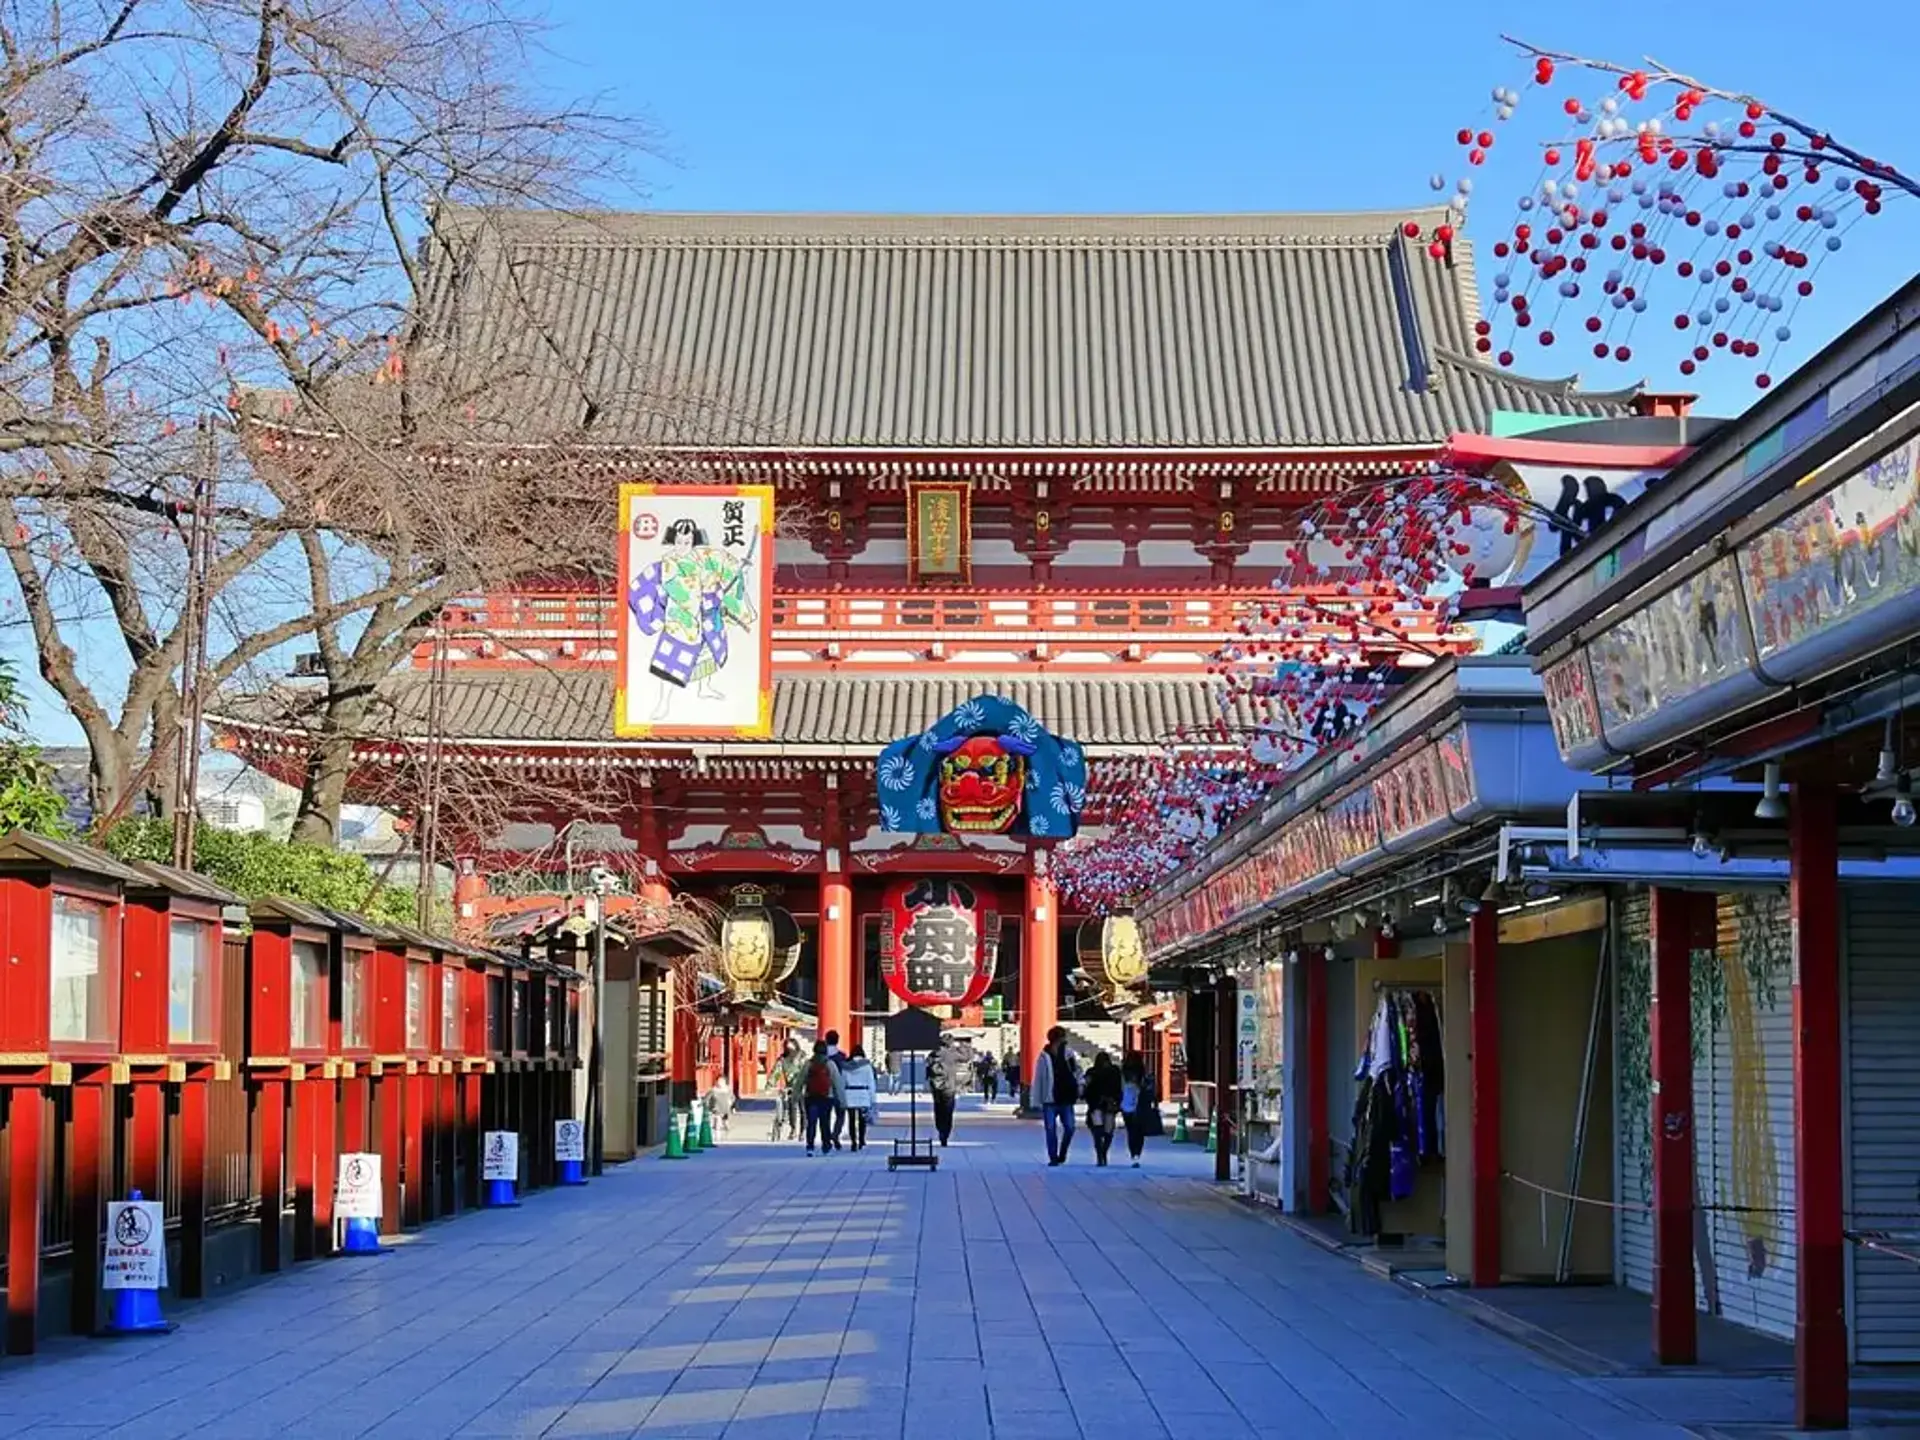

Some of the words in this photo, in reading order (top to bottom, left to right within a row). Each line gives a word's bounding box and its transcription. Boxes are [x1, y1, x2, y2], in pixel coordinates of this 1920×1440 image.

[722, 500, 745, 547] 賀正
[902, 879, 977, 999] 小舟町
